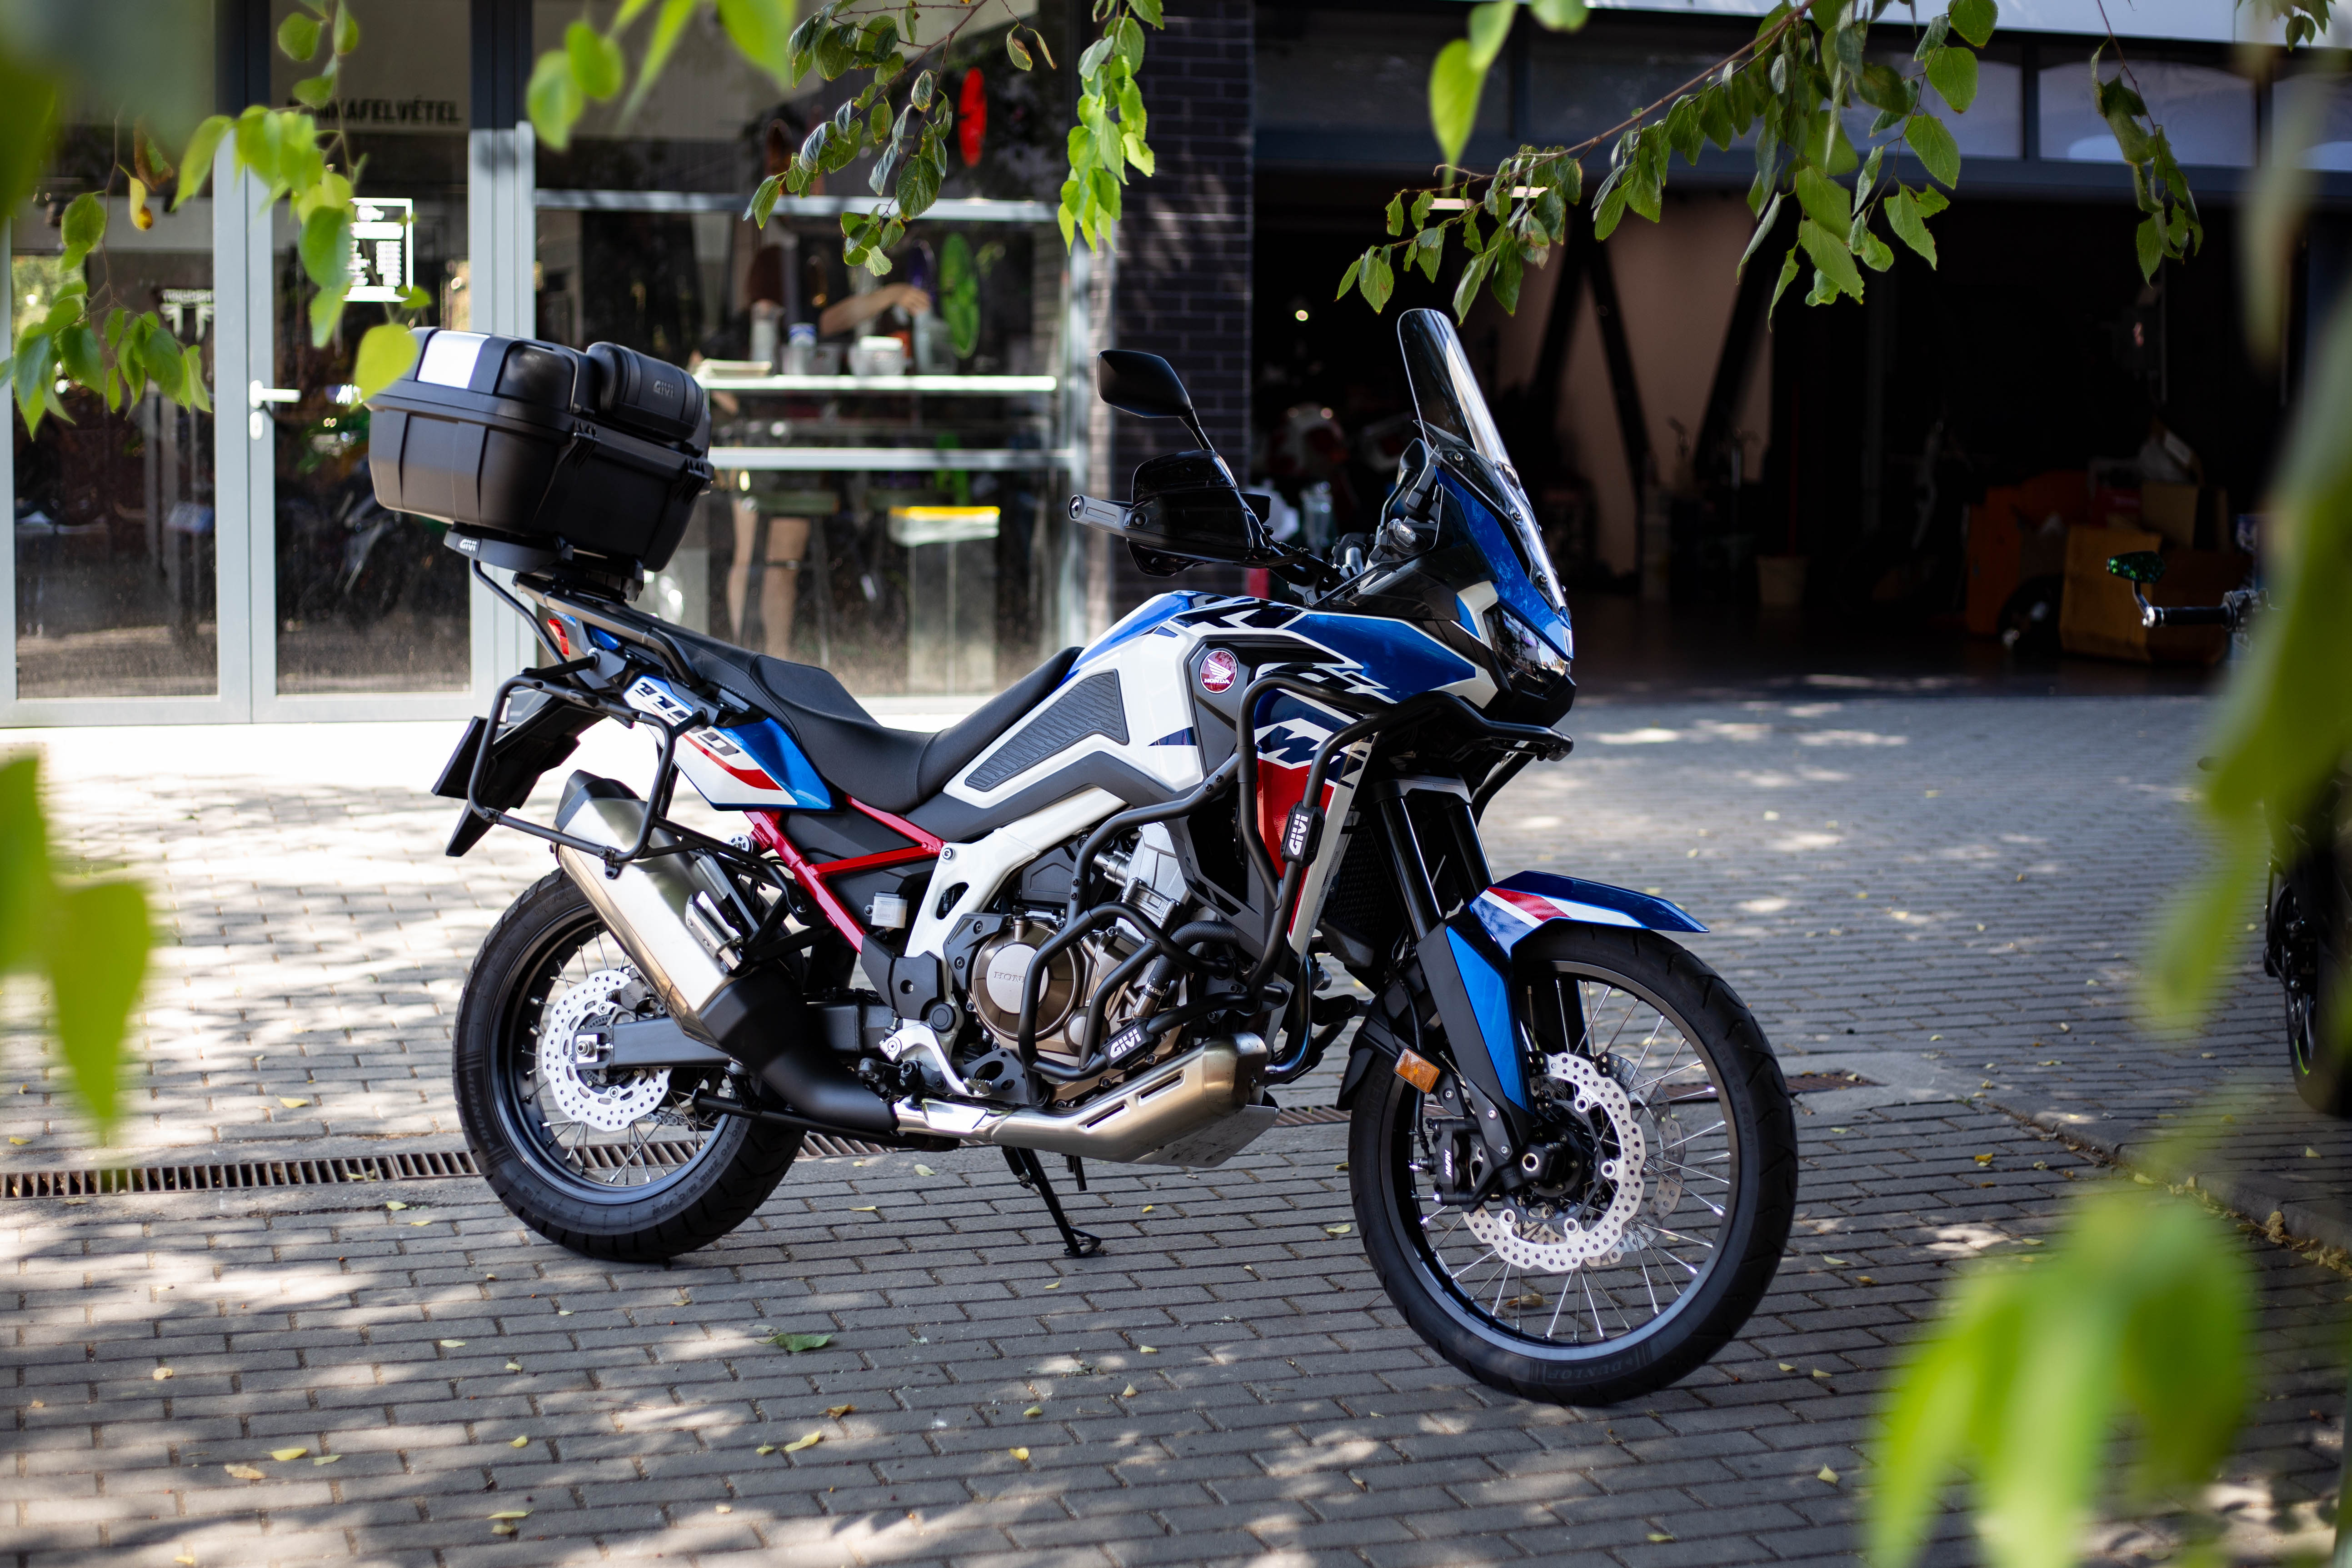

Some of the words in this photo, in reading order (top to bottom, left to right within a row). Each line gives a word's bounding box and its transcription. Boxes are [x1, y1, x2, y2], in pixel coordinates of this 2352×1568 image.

[653, 380, 674, 399] GIVI
[459, 539, 477, 552] GIVI
[1289, 814, 1308, 855] GIVI
[994, 971, 1026, 983] HON
[1110, 1028, 1142, 1058] GIVI
